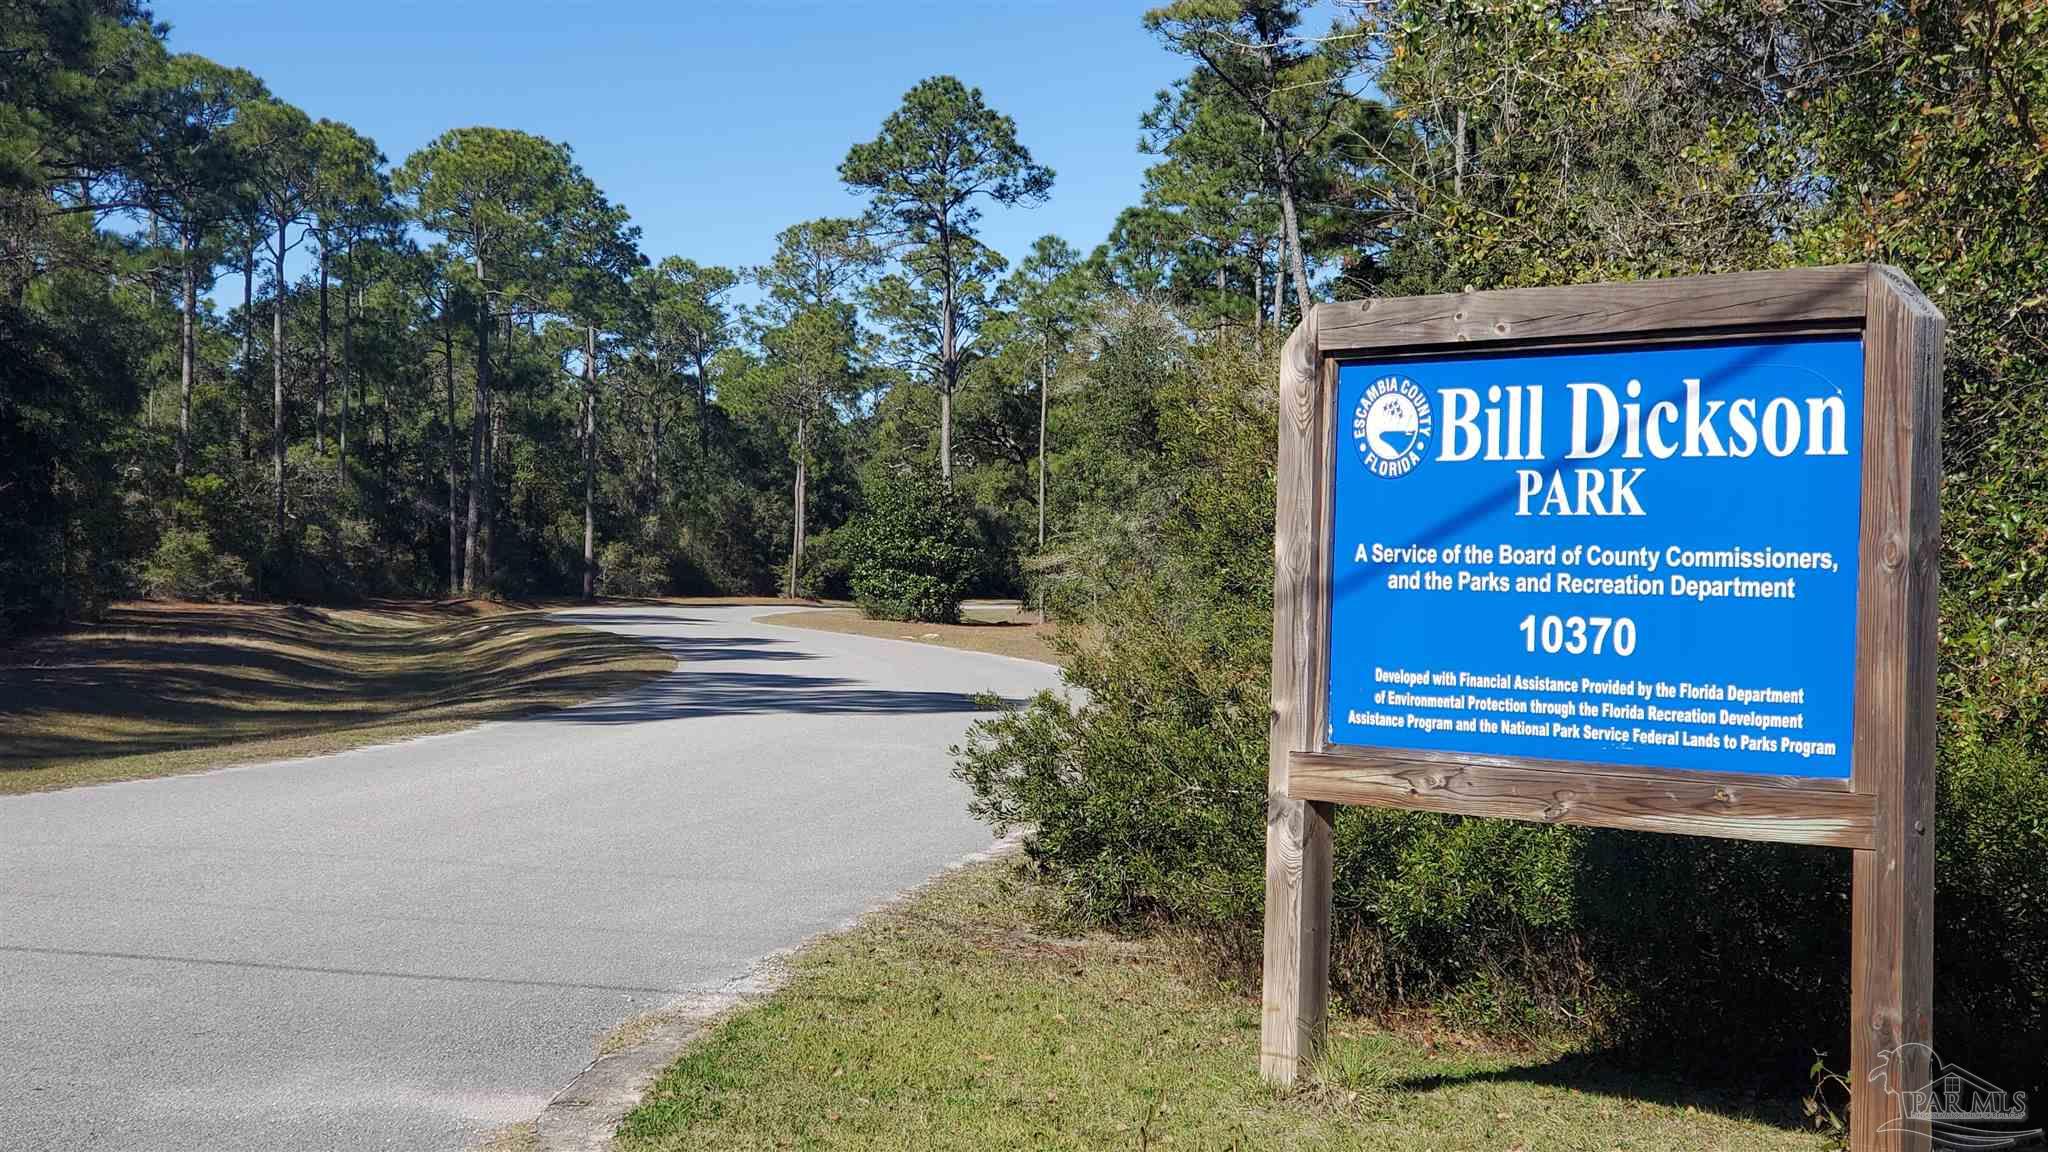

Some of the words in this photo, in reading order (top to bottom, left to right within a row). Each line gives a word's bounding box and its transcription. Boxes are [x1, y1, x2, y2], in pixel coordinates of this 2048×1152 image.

[1353, 376, 1399, 439] ESCAMBIA
[1400, 379, 1432, 438] COUNTY
[1435, 384, 1545, 462] Bill
[1564, 378, 1849, 459] Dickson
[1364, 451, 1421, 477] FLORIDA
[1514, 467, 1647, 516] PARK
[1354, 543, 1368, 562] A
[1371, 543, 1438, 564] Service
[1442, 543, 1462, 564] of
[1464, 544, 1494, 565] the
[1499, 544, 1556, 565] Board
[1561, 544, 1583, 566] of
[1586, 544, 1661, 572] County
[1665, 545, 1838, 573] Commissioners,
[1387, 570, 1421, 590] and
[1423, 570, 1453, 591] the
[1458, 570, 1510, 593] Parks
[1515, 572, 1552, 593] and
[1556, 572, 1665, 595] Recreation
[1670, 574, 1796, 601] Department
[1519, 614, 1636, 657] 10370
[1375, 666, 1430, 688] Developed
[1432, 671, 1457, 686] with
[1459, 671, 1511, 689] Financial
[1513, 675, 1579, 693] Assistance
[1581, 677, 1635, 696] Provided
[1637, 681, 1653, 700] by
[1655, 681, 1677, 698] the
[1679, 682, 1724, 701] Florida
[1727, 684, 1804, 705] Department
[1374, 690, 1386, 705] of
[1387, 690, 1465, 709] Environmental
[1467, 695, 1528, 713] Protection
[1529, 699, 1576, 719] through
[1578, 701, 1599, 717] the
[1601, 702, 1645, 720] Florida
[1647, 705, 1717, 724] Recreation
[1719, 709, 1804, 730] Development
[1348, 709, 1405, 728] Assistance
[1406, 713, 1453, 733] Program
[1455, 717, 1477, 732] and
[1479, 718, 1499, 734] the
[1500, 719, 1550, 737] National
[1552, 722, 1581, 739] Park
[1583, 724, 1630, 742] Service
[1632, 727, 1680, 746] Federal
[1682, 731, 1721, 748] Lands
[1723, 734, 1738, 750] to
[1740, 734, 1778, 752] Parks
[1780, 736, 1836, 758] Program
